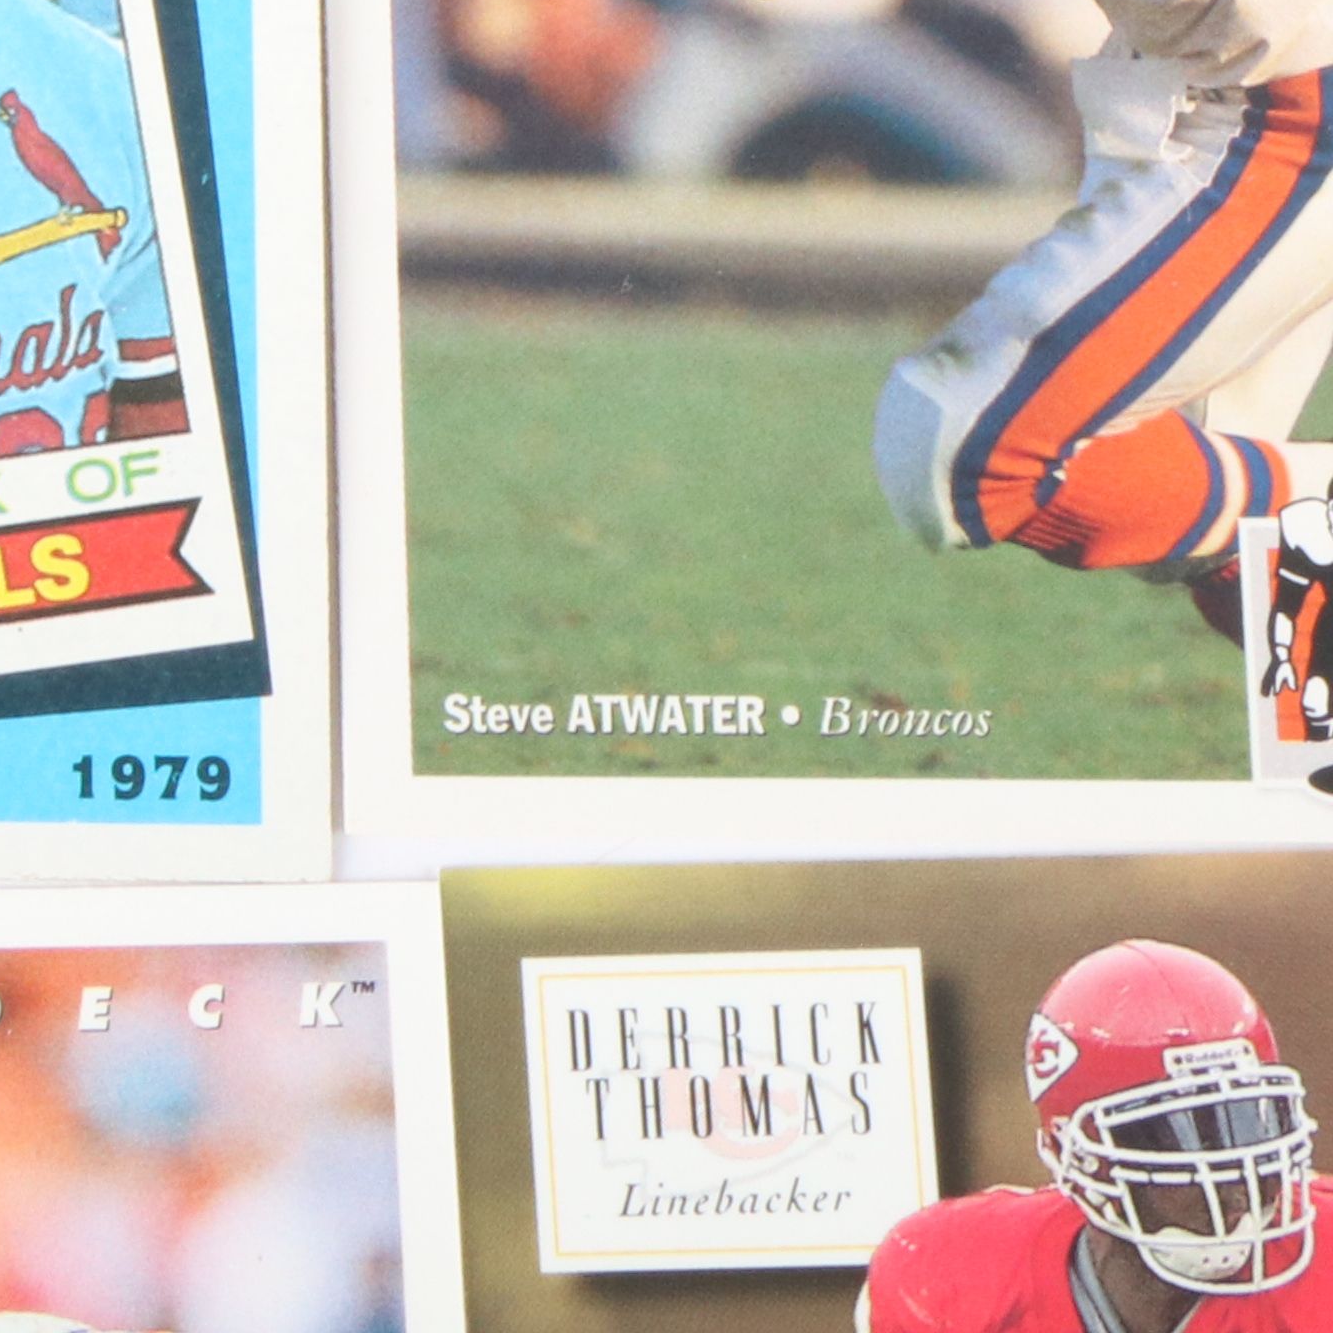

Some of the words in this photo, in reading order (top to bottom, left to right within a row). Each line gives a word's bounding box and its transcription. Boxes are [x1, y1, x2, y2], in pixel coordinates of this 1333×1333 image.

[65, 448, 162, 505] OF
[442, 692, 555, 735] Steve
[566, 693, 767, 736] ATWATER
[818, 694, 994, 739] Broncos
[71, 753, 233, 802] 1979
[566, 1001, 883, 1072] DERRICK
[585, 1071, 873, 1141] THOMAS
[618, 1176, 853, 1218] Linebacker
